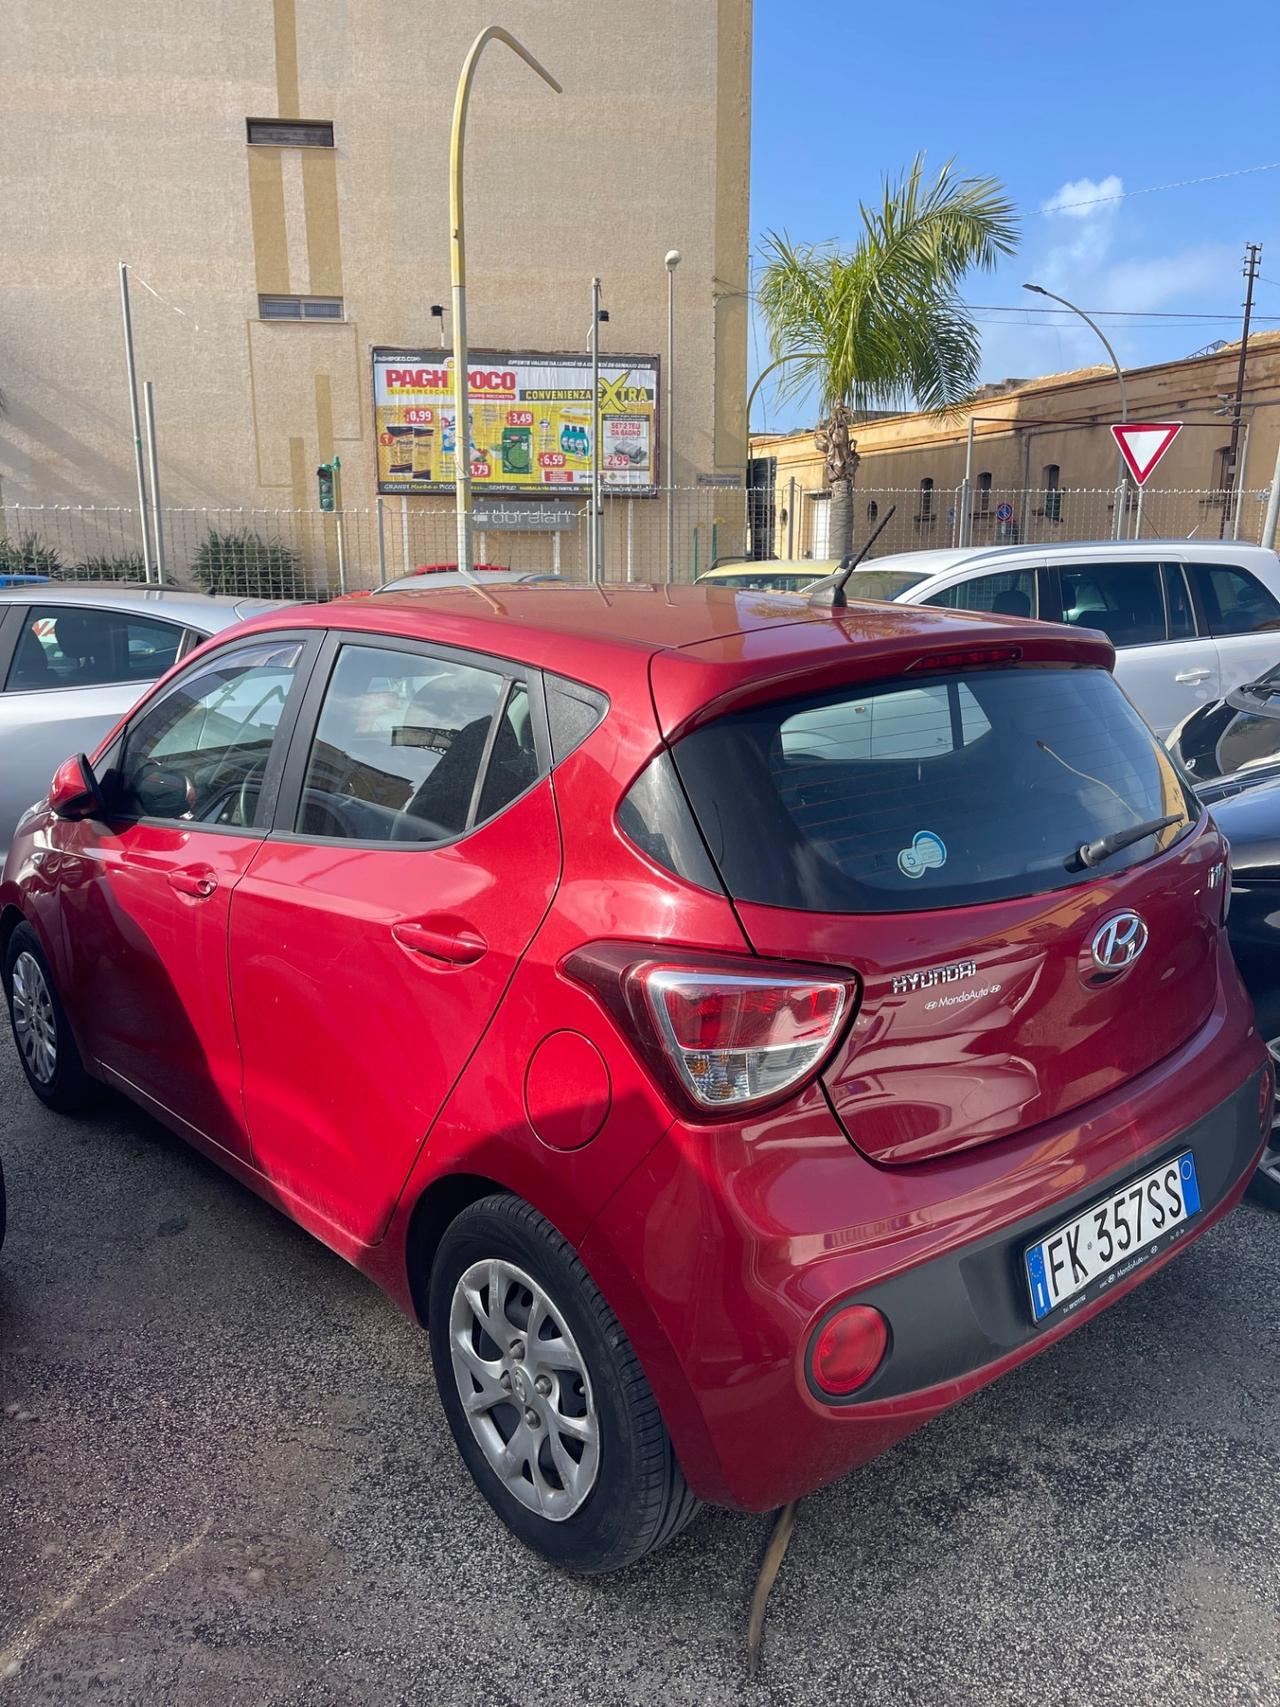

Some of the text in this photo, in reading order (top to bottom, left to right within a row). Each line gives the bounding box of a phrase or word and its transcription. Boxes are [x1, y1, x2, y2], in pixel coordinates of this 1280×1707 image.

[526, 389, 592, 400] CONVENIENZA
[410, 410, 431, 422] 0,99
[512, 413, 532, 424] 3,49
[544, 454, 563, 466] 6,59
[608, 455, 629, 467] 2,99
[470, 464, 488, 475] 1,79
[892, 960, 977, 994] HYUNDAI
[938, 988, 989, 1008] MondoAuto
[1048, 1169, 1183, 1298] FK 357SS
